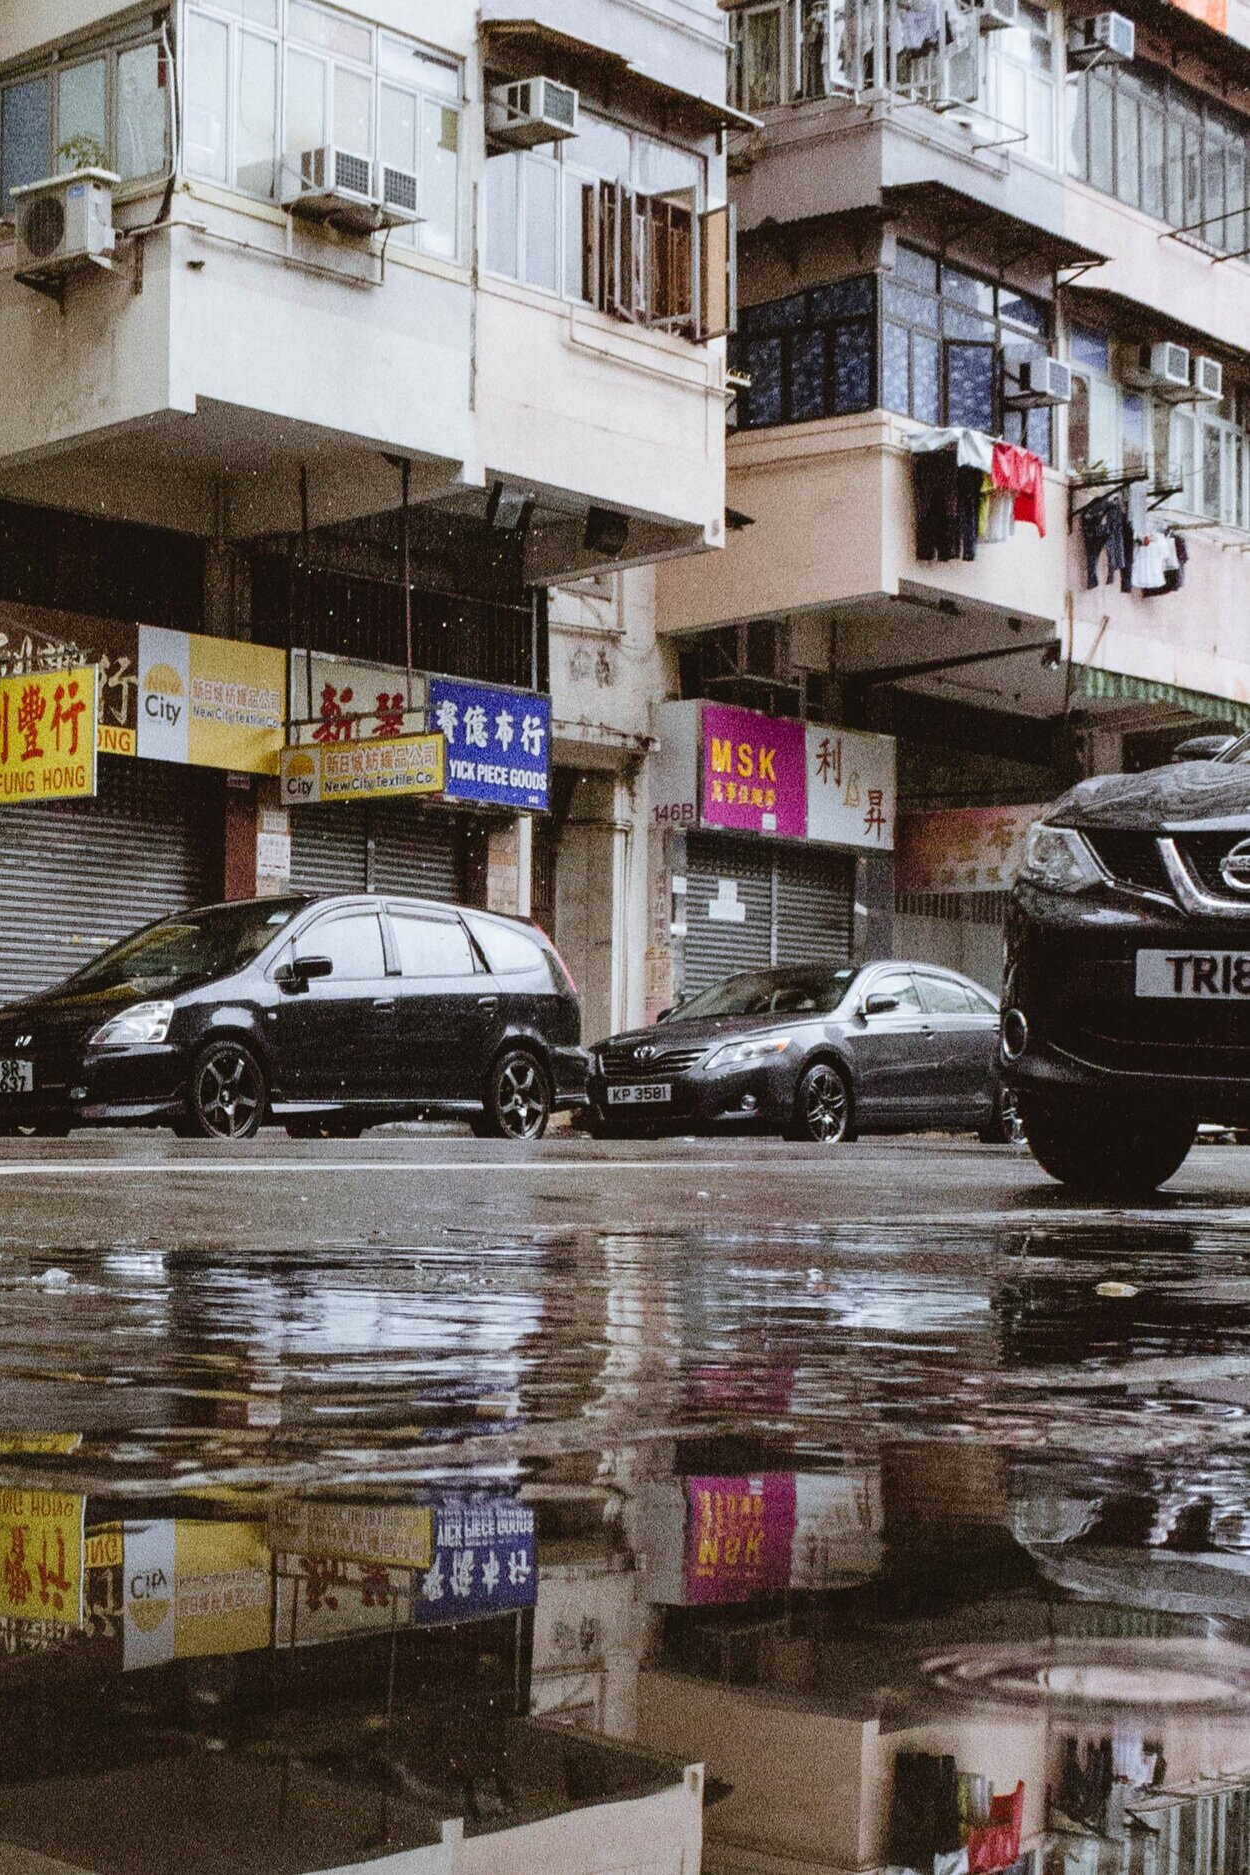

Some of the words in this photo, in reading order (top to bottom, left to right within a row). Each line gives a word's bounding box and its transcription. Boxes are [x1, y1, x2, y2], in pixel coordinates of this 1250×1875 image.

[145, 695, 181, 726] City
[711, 738, 776, 782] MSK
[42, 765, 86, 790] HONG
[324, 782, 349, 793] New
[351, 778, 374, 792] City
[449, 760, 476, 780] YICK
[477, 764, 509, 785] PIECE
[510, 768, 547, 791] GOODS
[287, 778, 313, 796] City
[653, 804, 693, 822] 146B
[613, 1089, 631, 1101] KP
